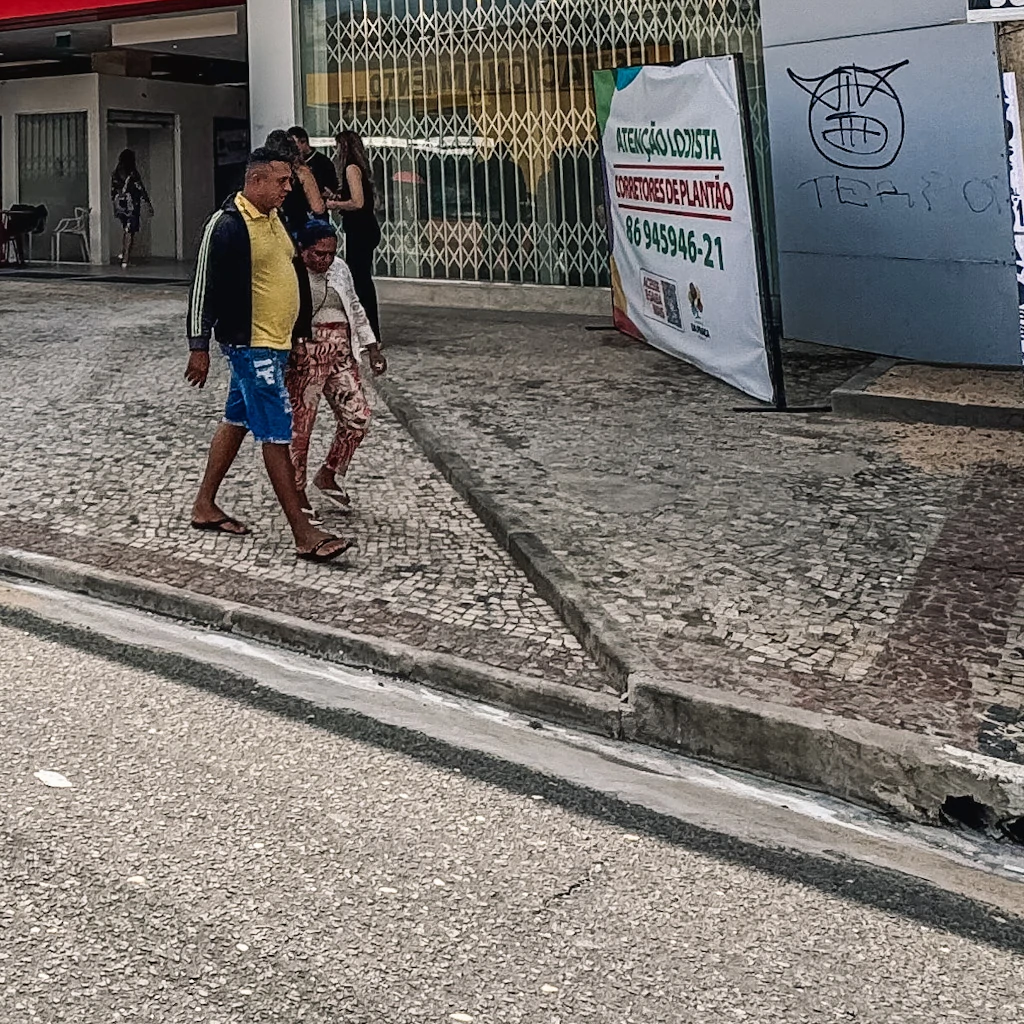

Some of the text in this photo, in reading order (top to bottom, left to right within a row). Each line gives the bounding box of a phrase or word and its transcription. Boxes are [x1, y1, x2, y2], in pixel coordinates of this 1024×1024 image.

[616, 121, 722, 162] ATENÇÃO LOJISTA
[615, 174, 734, 211] CORRETORES DE PLANTÃO
[626, 215, 724, 270] 86 945946-21
